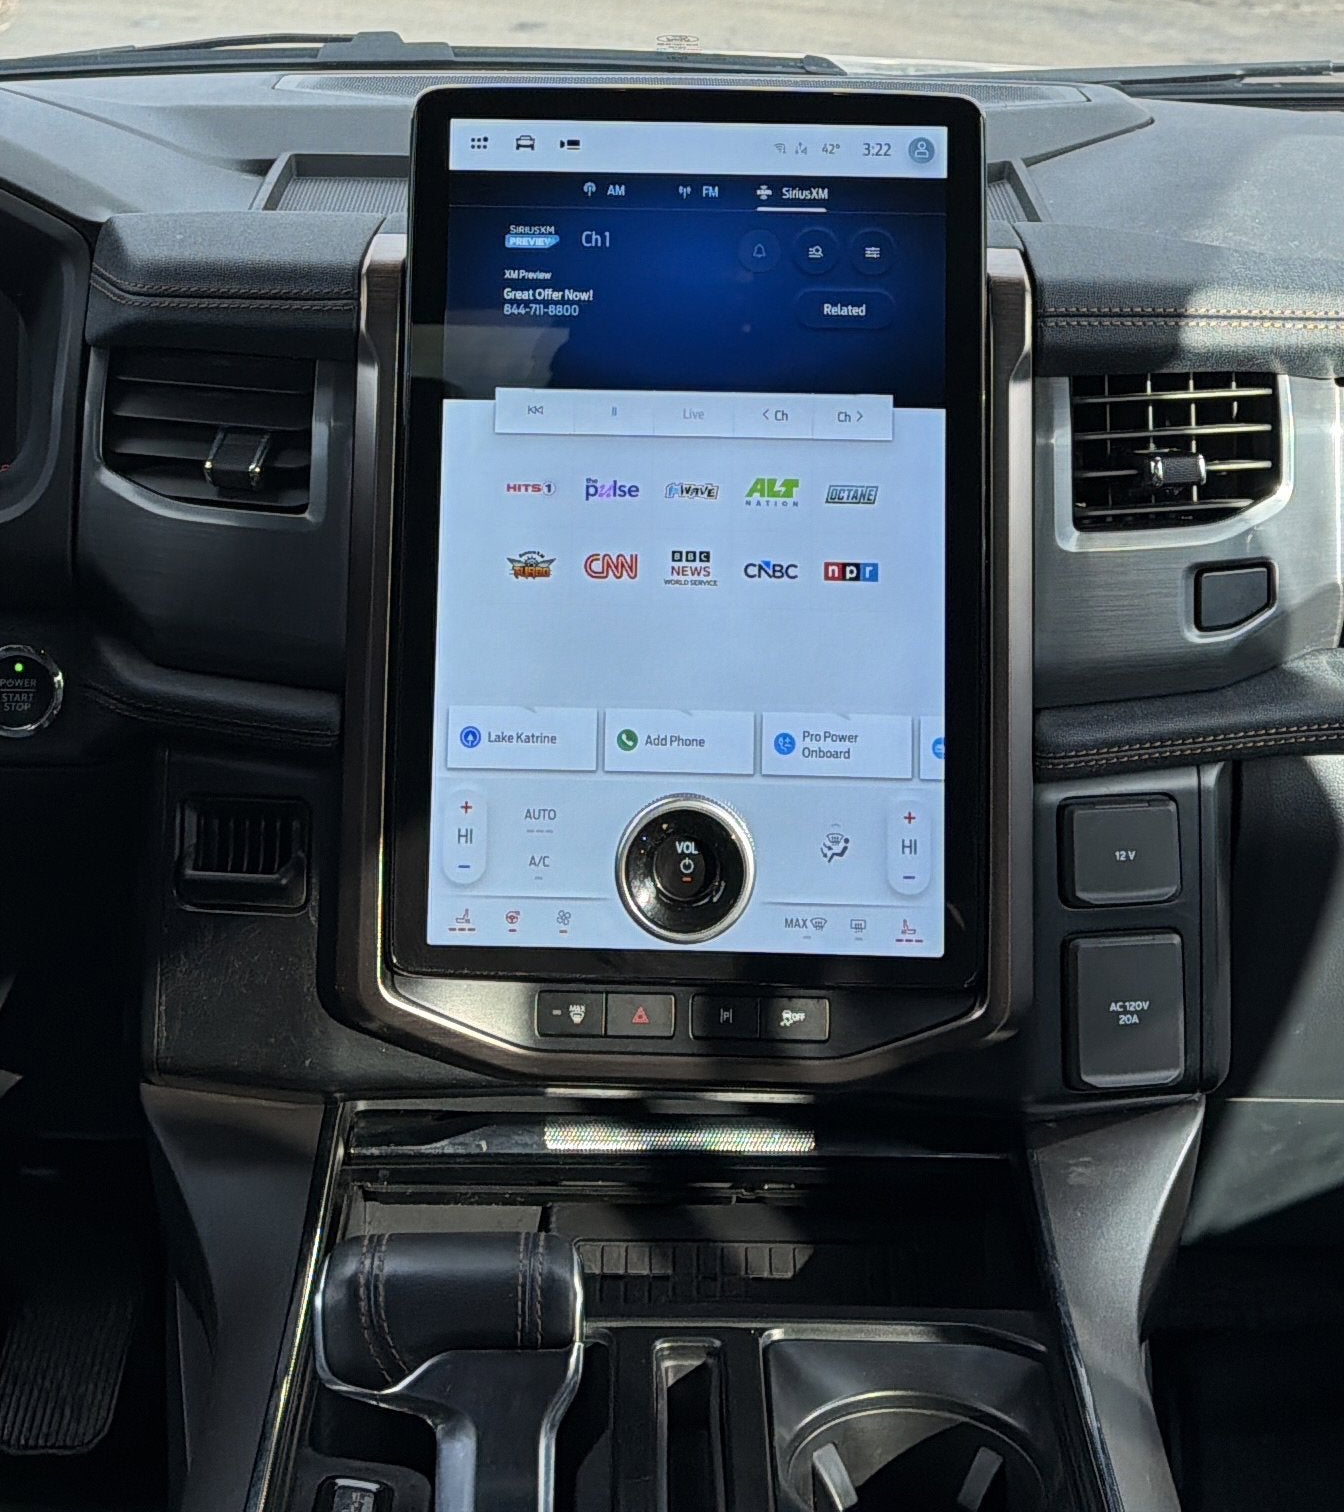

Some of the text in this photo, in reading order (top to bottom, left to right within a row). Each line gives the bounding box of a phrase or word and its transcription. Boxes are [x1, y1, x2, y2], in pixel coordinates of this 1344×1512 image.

[862, 143, 892, 157] 3:22
[607, 184, 626, 197] AM
[702, 186, 719, 197] FM
[782, 187, 829, 200] SiriusXM
[581, 231, 611, 247] Ch 1
[504, 269, 553, 280] XM Preview
[503, 288, 594, 301] Great Offer Now!
[503, 303, 580, 316] 844-711-8800
[823, 302, 867, 318] Related
[682, 407, 705, 421] Live
[774, 409, 789, 423] Ch
[837, 410, 852, 424] Ch
[585, 477, 598, 485] the
[506, 483, 542, 493] HITS
[585, 480, 640, 502] pulse
[745, 478, 800, 499] ALT
[828, 487, 875, 502] OCTANE
[672, 550, 710, 563] BBC
[584, 552, 638, 580] CNN
[671, 565, 711, 577] NEWS
[744, 560, 799, 580] CNBC
[827, 565, 874, 580] npr
[664, 578, 718, 587] WORLD SERVICE
[0, 677, 37, 689] POWER
[1, 693, 34, 703] START
[3, 702, 32, 713] STOP
[487, 730, 557, 745] Lake Katrine
[644, 734, 706, 749] Add Phone
[802, 730, 859, 744] Pro Power
[802, 746, 851, 761] Onboard
[524, 807, 557, 821] AUTO
[457, 828, 473, 846] HI
[676, 841, 698, 855] VOL
[901, 839, 918, 856] HI
[529, 855, 550, 868] A/C
[1114, 850, 1137, 861] 12 V
[784, 917, 808, 930] MAX
[568, 1004, 586, 1012] MAX
[1109, 1000, 1150, 1012] AC 120V
[791, 1012, 806, 1021] OFF
[1118, 1014, 1140, 1025] 20A
